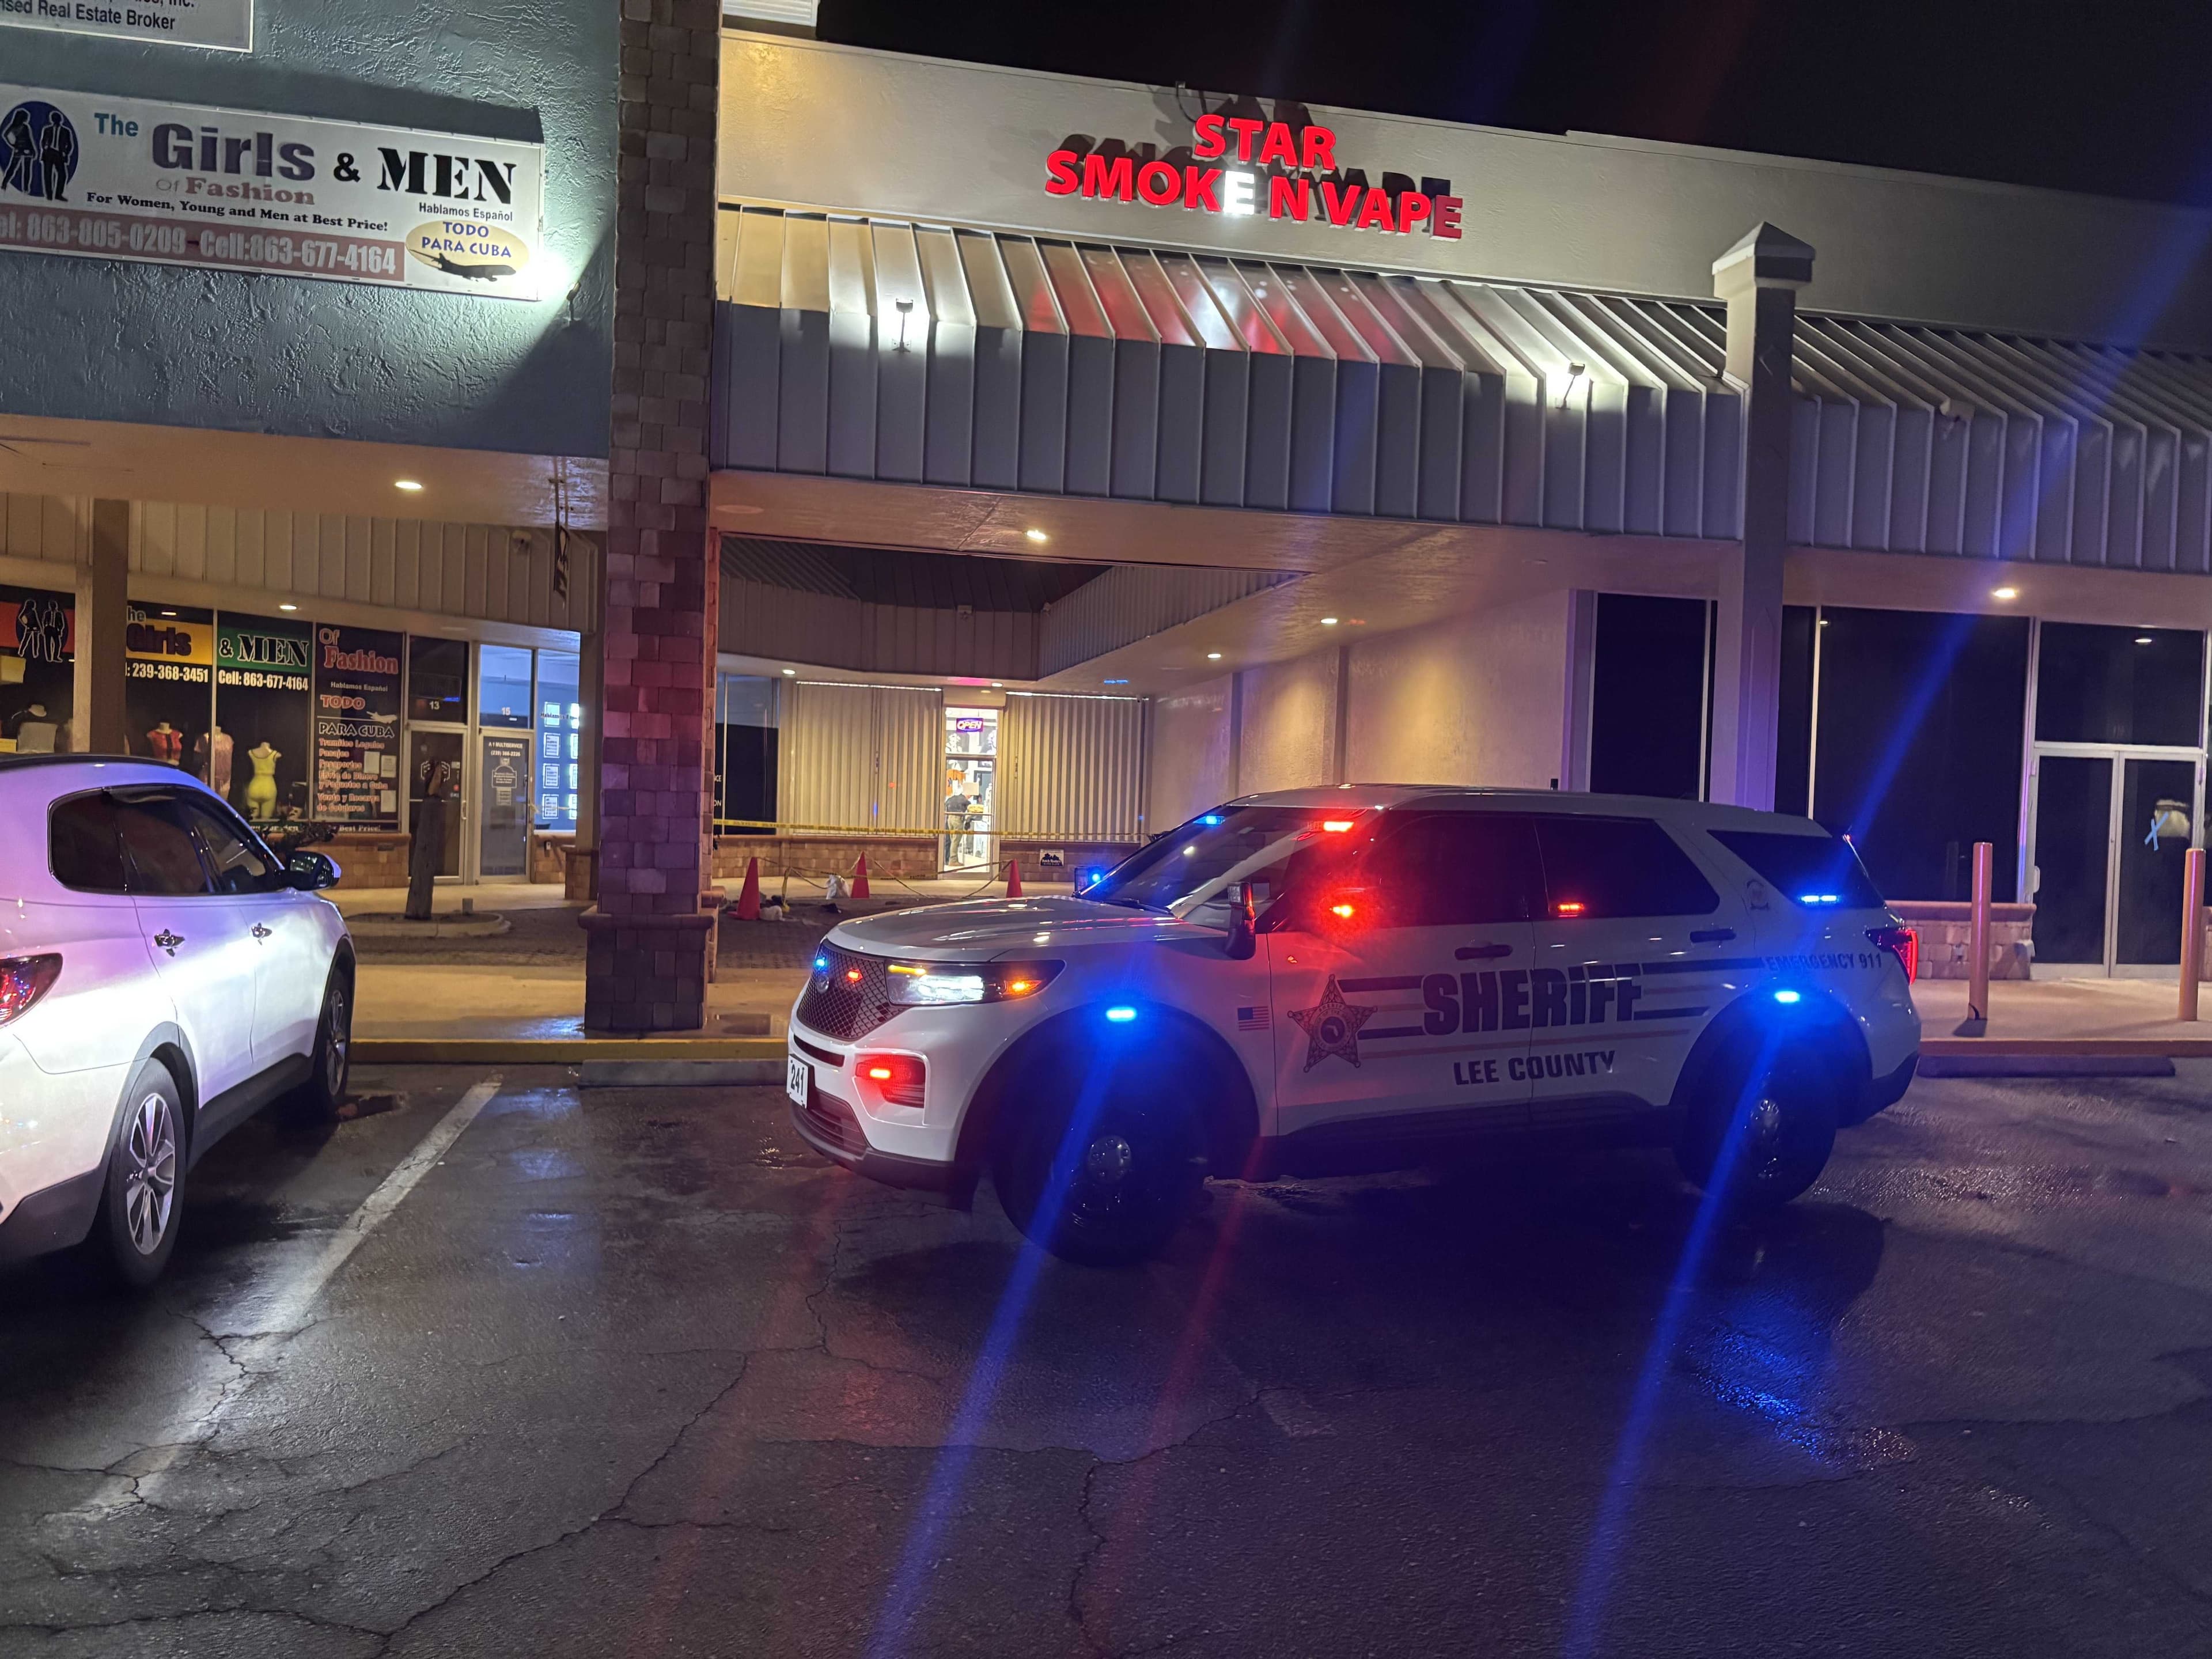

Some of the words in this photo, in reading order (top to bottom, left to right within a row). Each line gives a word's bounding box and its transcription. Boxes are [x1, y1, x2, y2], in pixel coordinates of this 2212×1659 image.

[38, 0, 70, 18] Real
[76, 3, 122, 24] Estate
[127, 9, 175, 29] Broker
[94, 113, 139, 137] The
[1194, 113, 1336, 172] STAR
[152, 123, 315, 181] Girls
[333, 152, 361, 183] &
[377, 147, 517, 204] MEN
[156, 177, 181, 192] Of
[185, 176, 315, 206] Fashion
[1044, 149, 1255, 216] SMOKE
[1270, 175, 1309, 224] N
[1319, 180, 1463, 241] VAPE
[86, 192, 113, 204] For
[117, 195, 175, 211] Women,
[179, 200, 225, 217] Young
[229, 207, 256, 218] and
[259, 208, 289, 221] Men
[293, 213, 308, 223] at
[312, 214, 344, 227] Best
[347, 218, 388, 232] Price!
[419, 202, 470, 217] Hablamos
[473, 207, 513, 222] Español
[442, 221, 490, 238] TODO
[421, 236, 464, 252] PARA
[469, 243, 512, 258] CUBA
[319, 627, 340, 646] Of
[219, 638, 234, 658] &
[237, 634, 309, 667] MEN
[324, 645, 399, 675] Fashion
[132, 662, 209, 683] 239-368-3451
[218, 669, 242, 685] Cell:
[243, 671, 309, 691] 863-677-4164
[331, 681, 362, 690] Hablamos
[363, 683, 388, 692] Español
[320, 694, 366, 710] TODO
[429, 700, 440, 710] 13
[501, 707, 511, 716] 15
[319, 722, 358, 736] PARA
[358, 724, 395, 738] CUBA
[957, 719, 983, 729] OPEN
[1858, 952, 1882, 969] 911
[1453, 1059, 1498, 1085] LEE
[1509, 1050, 1616, 1081] COUNTY
[790, 1063, 805, 1096] 241
